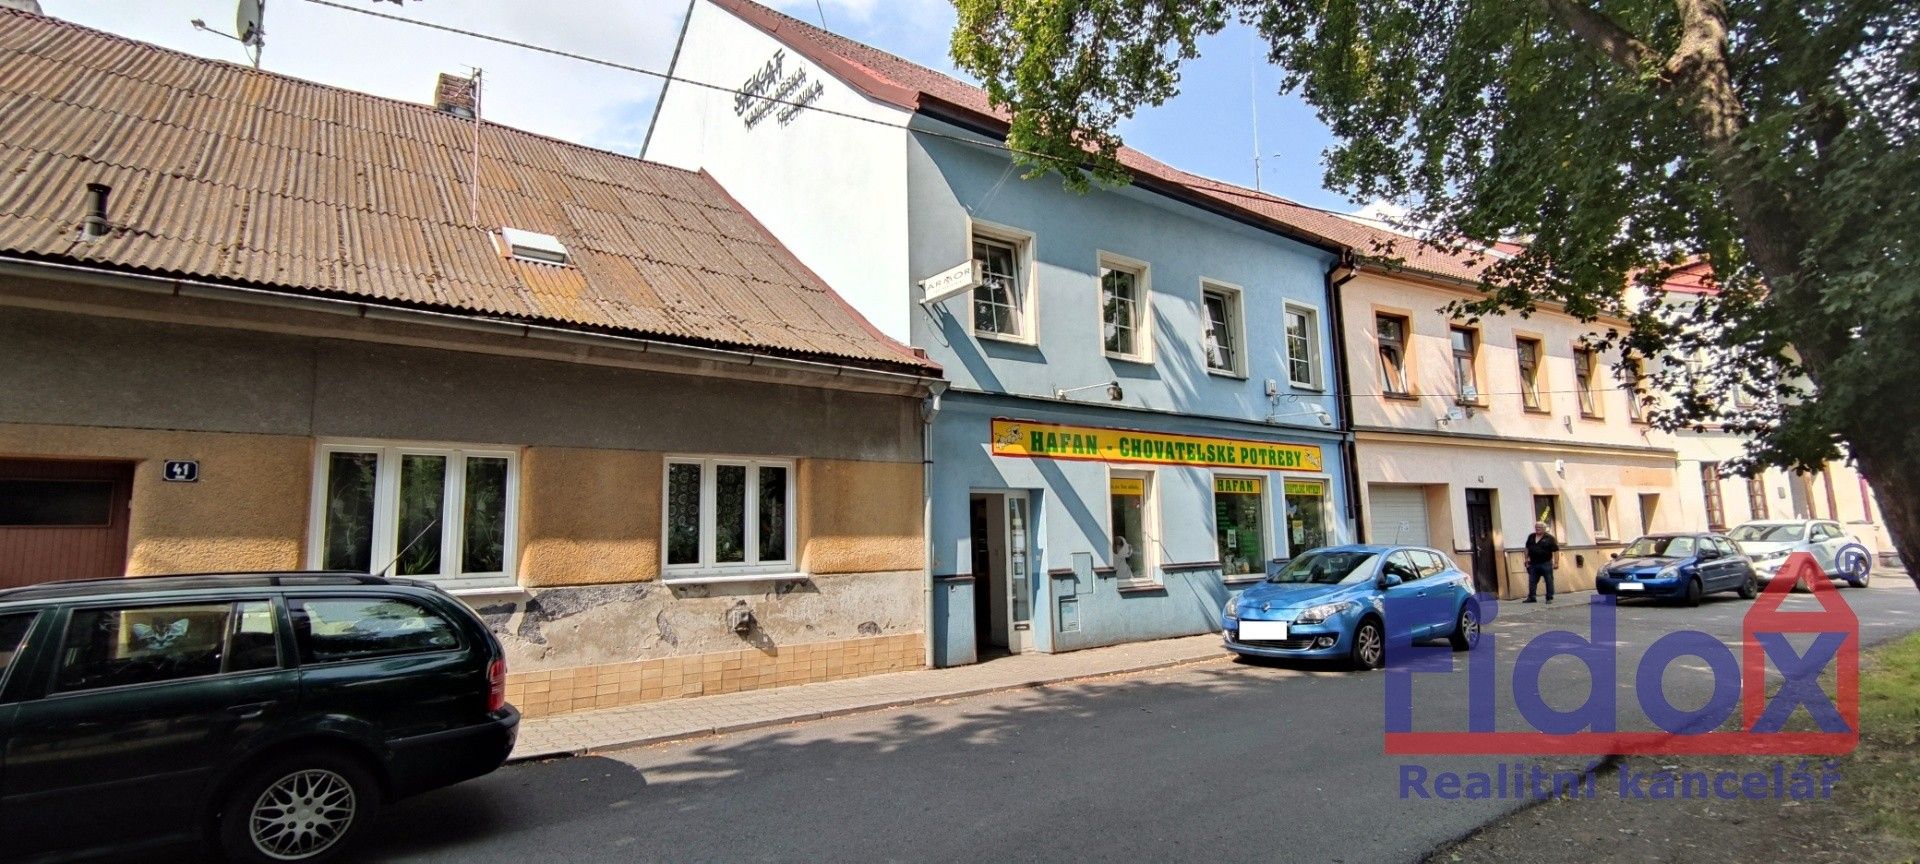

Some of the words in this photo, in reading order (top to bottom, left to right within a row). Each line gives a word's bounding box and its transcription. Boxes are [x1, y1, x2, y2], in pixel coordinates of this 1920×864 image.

[734, 48, 785, 117] SEKAT
[776, 80, 824, 130] TECHNIKA
[927, 267, 970, 290] ARMOR
[1030, 431, 1098, 455] HAFAN
[1119, 437, 1236, 464] CHOVATELSKÉ
[1240, 445, 1302, 467] POTŘEBY
[172, 463, 189, 476] 41
[1217, 479, 1254, 492] HAFAN
